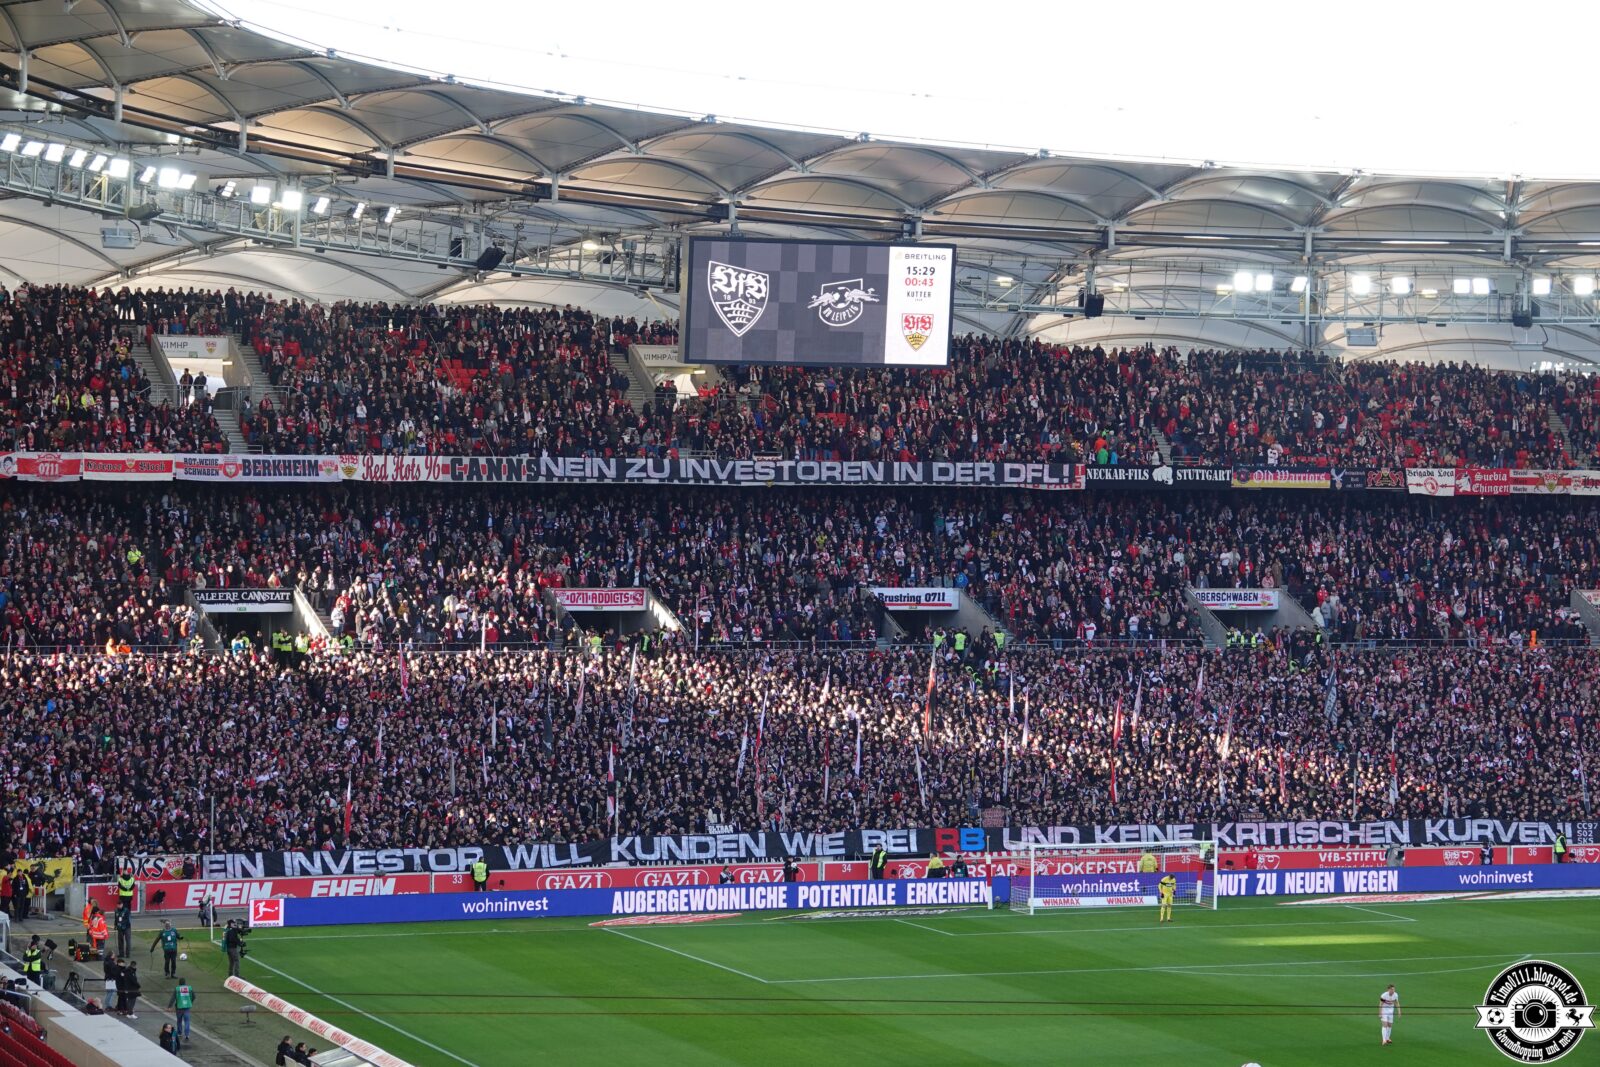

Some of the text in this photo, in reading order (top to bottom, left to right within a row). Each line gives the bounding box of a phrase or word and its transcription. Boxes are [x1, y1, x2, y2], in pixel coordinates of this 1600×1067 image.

[904, 253, 947, 261] BREITLING
[906, 266, 936, 276] 15:29
[904, 277, 934, 287] 00:43
[906, 290, 932, 298] KUTTER
[831, 304, 859, 321] LEIPZIG
[169, 341, 189, 349] MHP
[38, 462, 59, 475] 0711
[183, 467, 220, 476] SCHWABEN
[241, 459, 320, 477] BERKHEIM
[361, 454, 441, 481] Red Hots 96
[539, 457, 617, 478] NEIN
[625, 458, 670, 479] ZU
[679, 459, 885, 482] INVESTOREN
[893, 461, 923, 482] IN
[932, 462, 996, 483] DER
[1085, 467, 1150, 481] NECKAR-FILS
[1176, 468, 1232, 481] STUTTGART
[1252, 469, 1326, 484] Old Warriors
[1474, 471, 1508, 481] Suebia
[241, 590, 291, 602] CANNSTATT
[591, 592, 630, 603] ADDICTS
[877, 592, 946, 604] Brustring 0711
[1195, 592, 1259, 602] OBERSCHWABEN
[1576, 822, 1599, 830] CC97
[202, 852, 265, 880] EIN
[283, 846, 484, 878] INVESTOR
[503, 843, 593, 870] WILL
[610, 832, 767, 862] KUNDEN
[780, 831, 846, 856] WIE
[861, 828, 918, 854] BEI
[935, 828, 985, 853] RB
[1002, 826, 1080, 851] UND
[1095, 823, 1195, 848] KEINE
[1211, 820, 1411, 846] KRITISCHEN
[1528, 848, 1537, 856] 36
[1181, 855, 1191, 864] 35
[1318, 851, 1405, 862] VfB-STIFTU
[841, 864, 852, 873] 34
[1053, 860, 1141, 875] JOKERSTA
[452, 874, 463, 884] 33
[544, 873, 603, 890] GAZI
[643, 870, 701, 886] GAZI
[739, 870, 785, 884] GAZ
[1216, 869, 1399, 896] MUT ZU NEUEN WEGEN
[1458, 870, 1534, 885] wohninvest
[107, 885, 119, 896] 32
[310, 877, 397, 898] EHEIM
[1061, 879, 1140, 894] wohninvest
[184, 881, 274, 907] EHEIM
[797, 882, 897, 908] POTENTIALE
[906, 880, 989, 905] ERKENNEN
[462, 896, 549, 914] wohninvest
[1042, 897, 1081, 906] WINAMAX
[1106, 896, 1145, 905] WINAMAX
